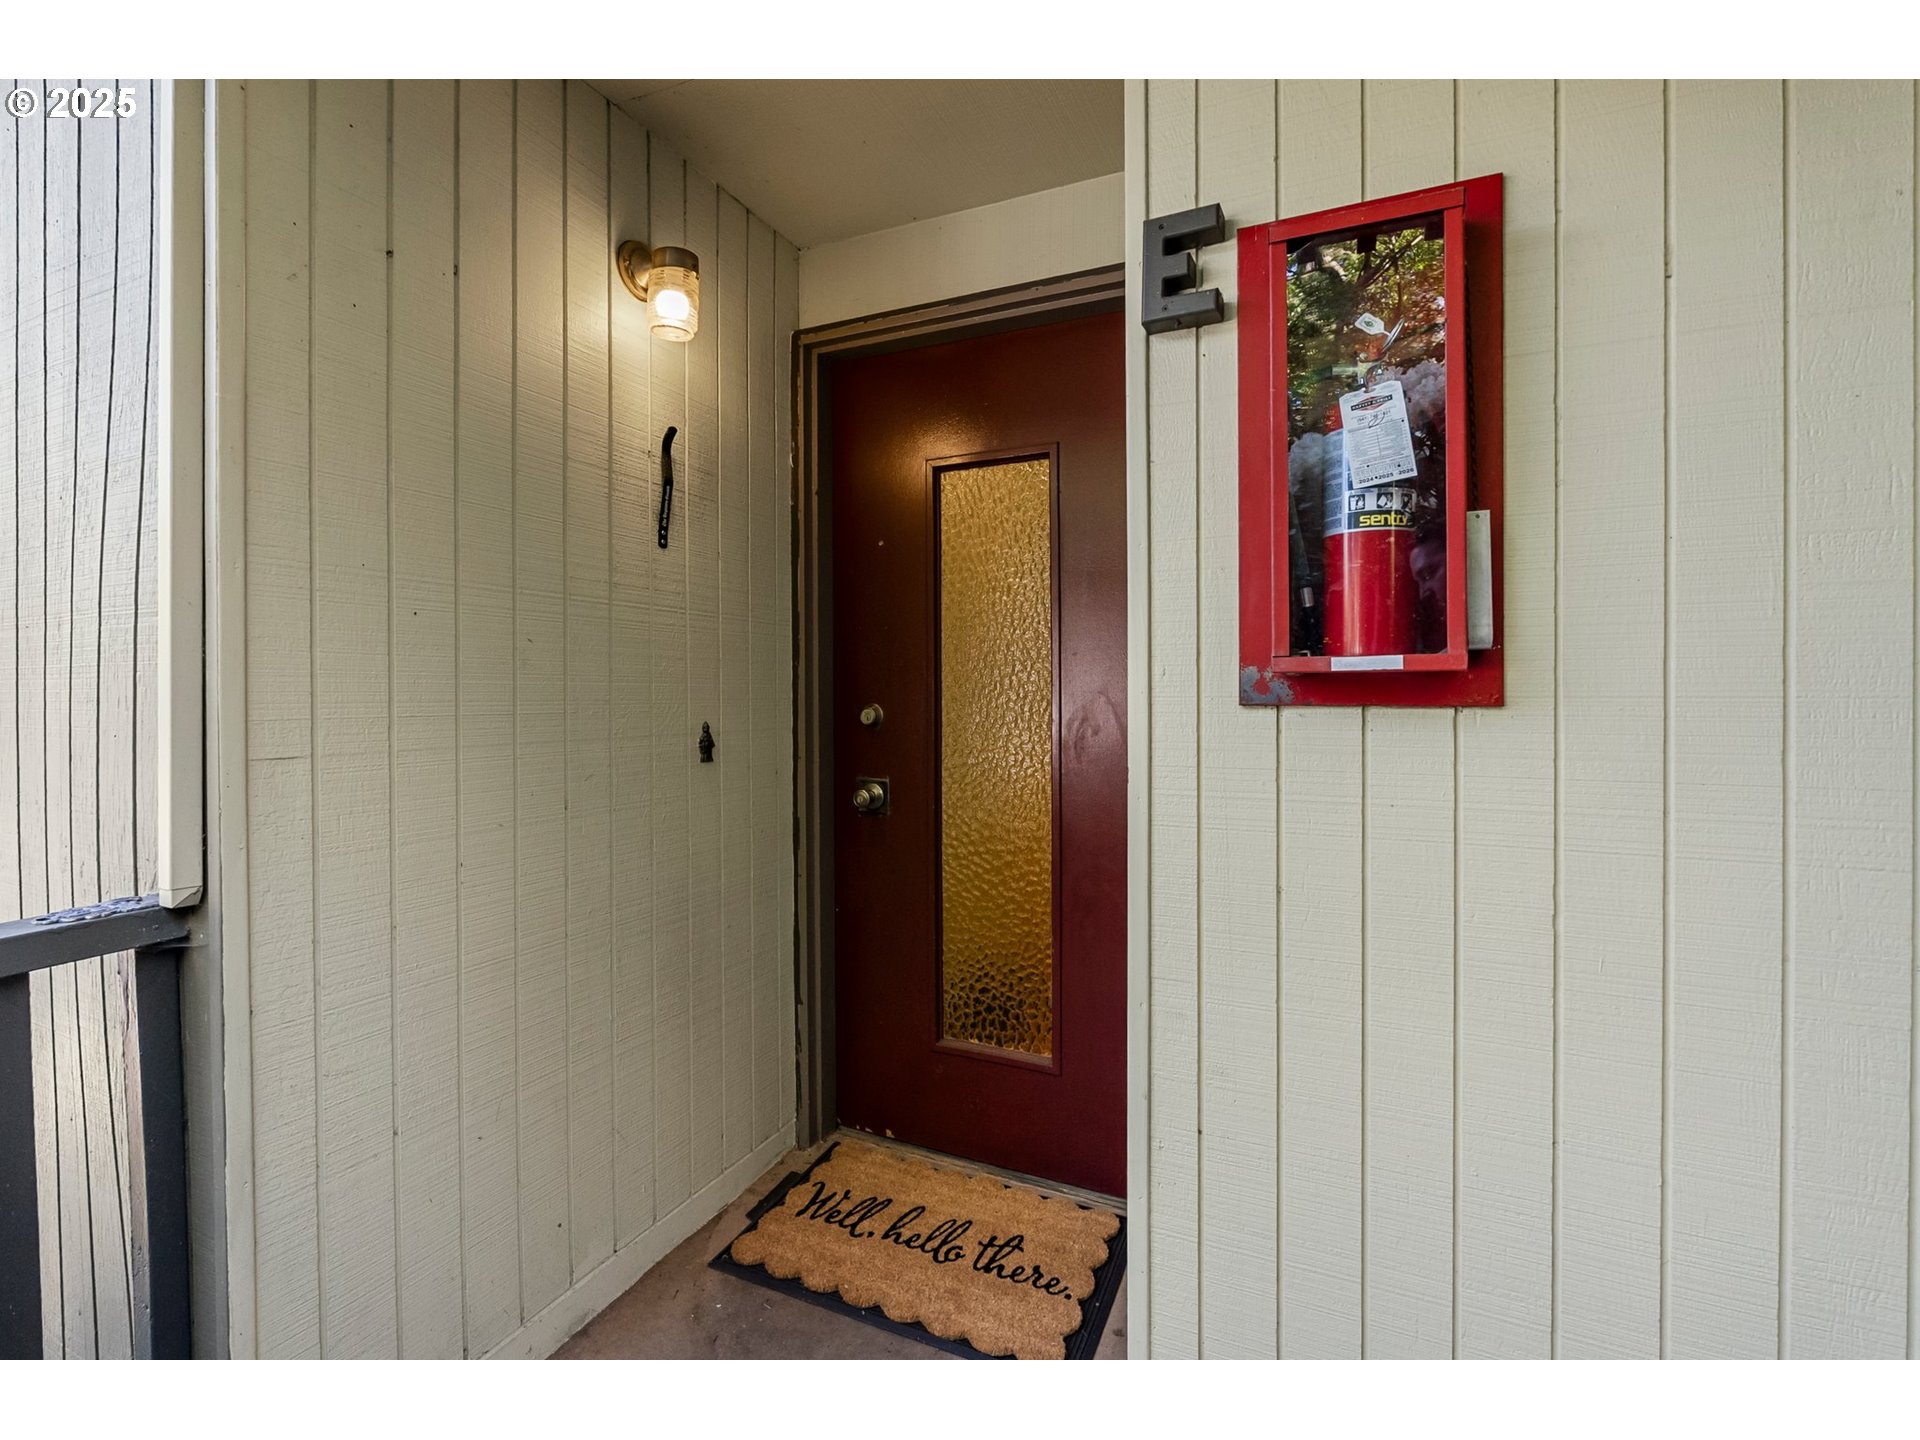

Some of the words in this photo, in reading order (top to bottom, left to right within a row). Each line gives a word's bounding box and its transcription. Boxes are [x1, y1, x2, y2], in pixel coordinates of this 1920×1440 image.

[1142, 203, 1225, 335] E
[1358, 476, 1374, 485] 2024
[1378, 472, 1394, 480] 2025
[1398, 467, 1415, 475] 2026
[1359, 511, 1408, 527] sentry
[881, 1206, 973, 1264] hello
[973, 1234, 1072, 1300] there.
